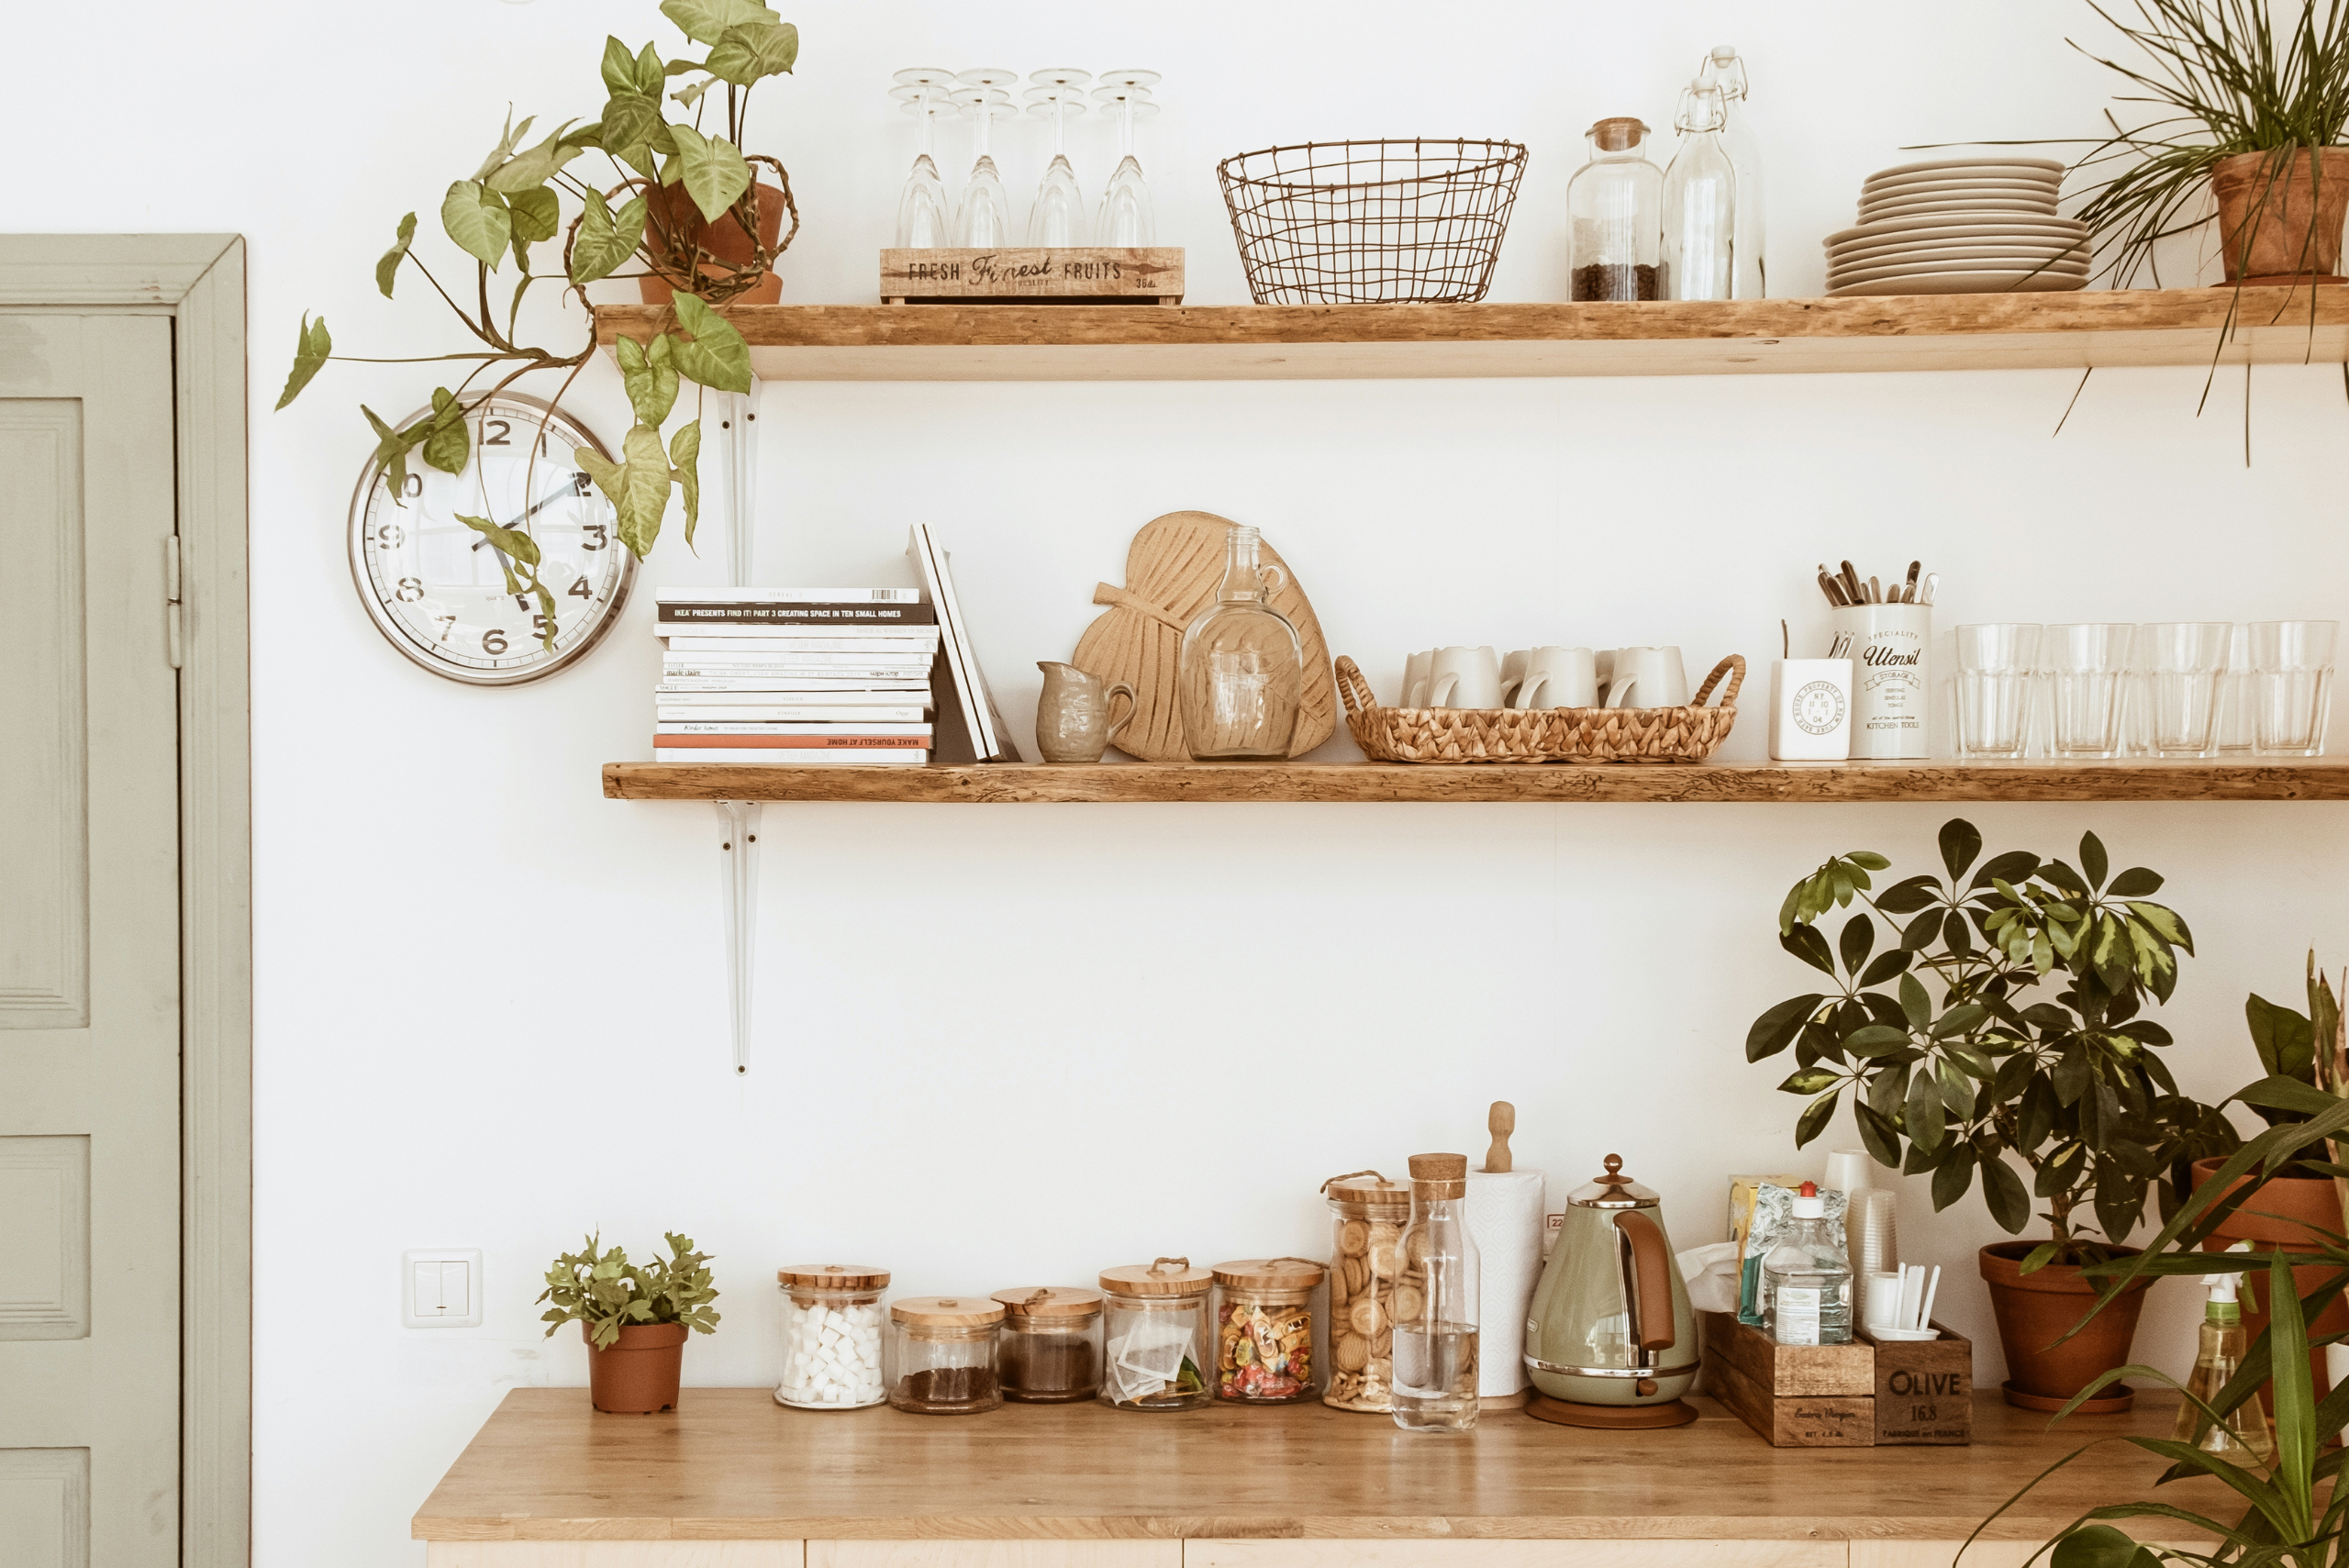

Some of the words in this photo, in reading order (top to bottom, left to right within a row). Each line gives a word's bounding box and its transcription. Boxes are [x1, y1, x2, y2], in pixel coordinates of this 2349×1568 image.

[908, 262, 960, 281] FRESH
[969, 254, 1052, 285] Finest
[1064, 261, 1121, 280] FRUITS
[478, 420, 511, 446] 12
[566, 472, 593, 497] 2
[377, 524, 406, 550] 9
[581, 524, 608, 551] 3
[395, 576, 425, 603] 8
[567, 573, 594, 600] 4
[692, 609, 726, 617] PRESENTS
[727, 609, 741, 617] FIND
[742, 609, 751, 617] IT!
[753, 609, 771, 617] PART
[772, 609, 776, 617] 3
[777, 609, 809, 617] CREATING
[810, 609, 831, 617] SPACE
[832, 609, 840, 617] IN
[841, 609, 854, 618] TEN
[855, 609, 877, 618] SMALL
[878, 609, 901, 618] HOMES
[434, 614, 457, 642] 7
[531, 613, 560, 640] 5
[1868, 630, 1919, 642] SPECIALITY
[481, 628, 509, 656] 6
[811, 640, 843, 650] MAGAZINE
[801, 653, 833, 662] MAGAZINE
[1863, 645, 1921, 667] Utensil
[1879, 672, 1909, 680] STORAGE
[1804, 683, 1838, 694] PROPERTY
[1834, 707, 1843, 723] NEW
[684, 723, 703, 731] Kinder
[827, 738, 848, 746] HOME
[800, 751, 832, 761] MAGAZINE
[1888, 1370, 1961, 1396] OLIVE
[1883, 1429, 1921, 1438] FABRIQUE
[1933, 1429, 1965, 1438] FRANCE
